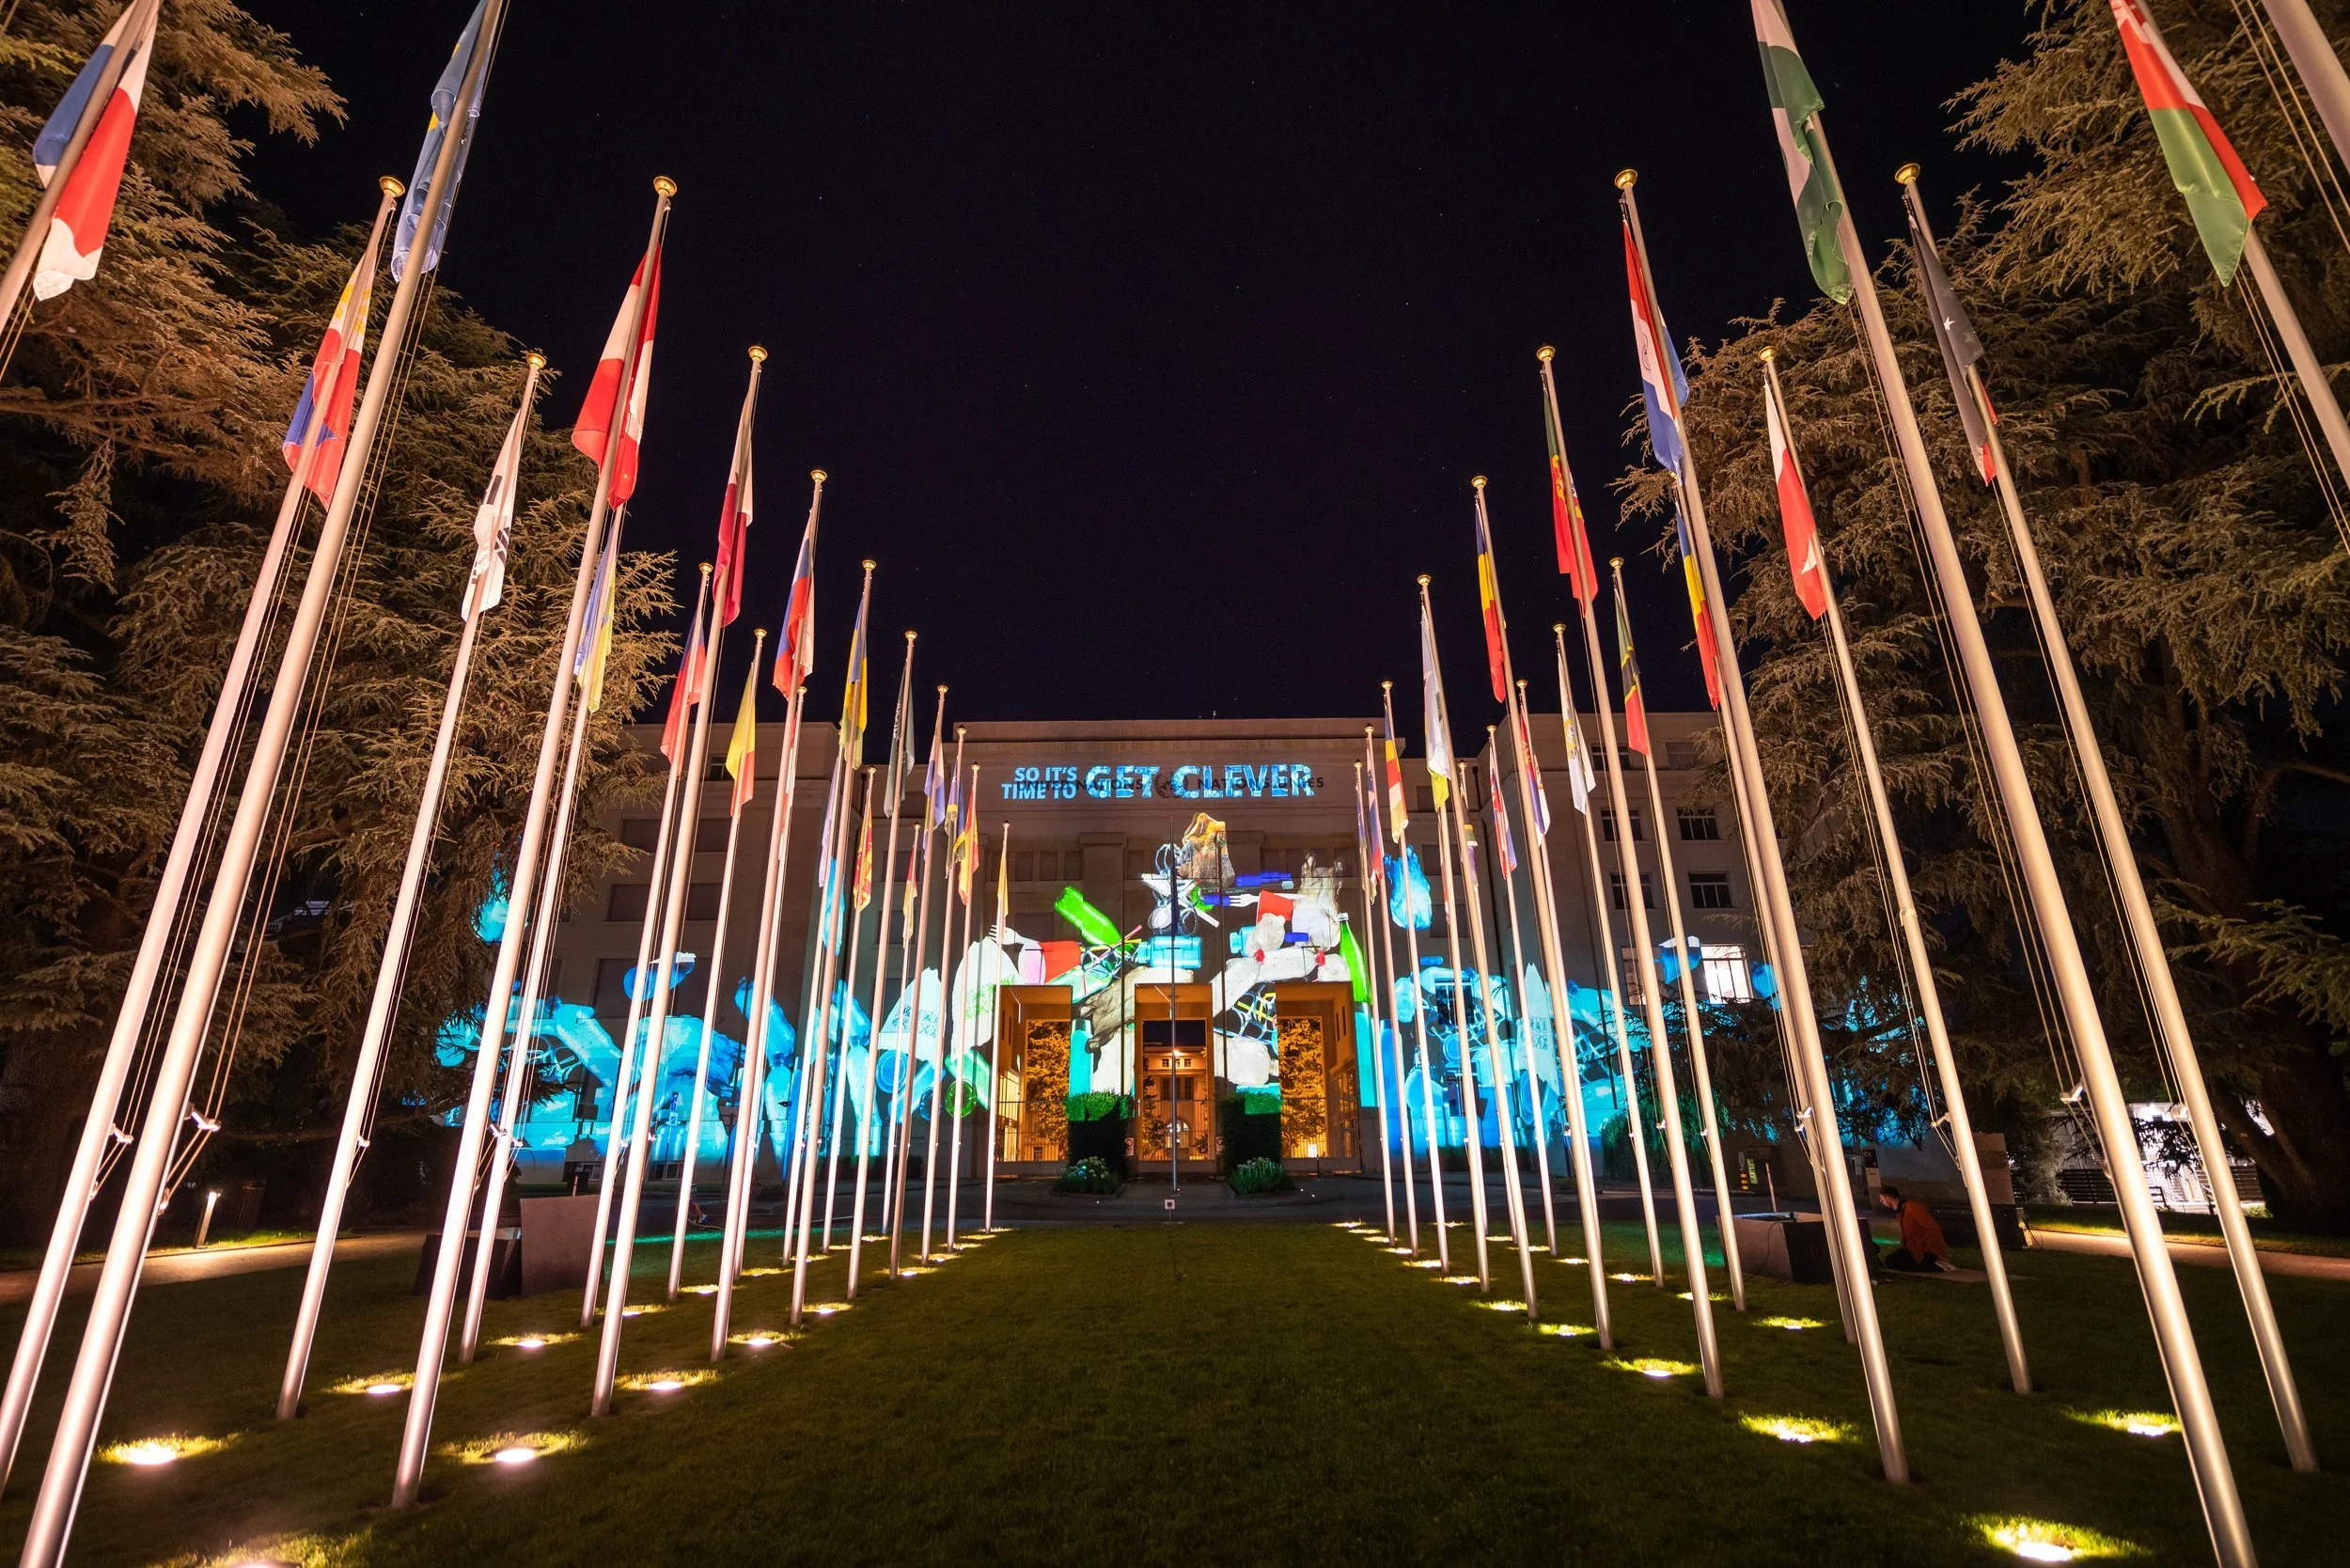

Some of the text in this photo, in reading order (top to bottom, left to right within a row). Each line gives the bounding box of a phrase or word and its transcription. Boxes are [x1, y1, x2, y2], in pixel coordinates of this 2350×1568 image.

[1014, 766, 1040, 782] SO
[1085, 763, 1315, 799] GET CLEVER
[1001, 783, 1078, 800] TIME TO
